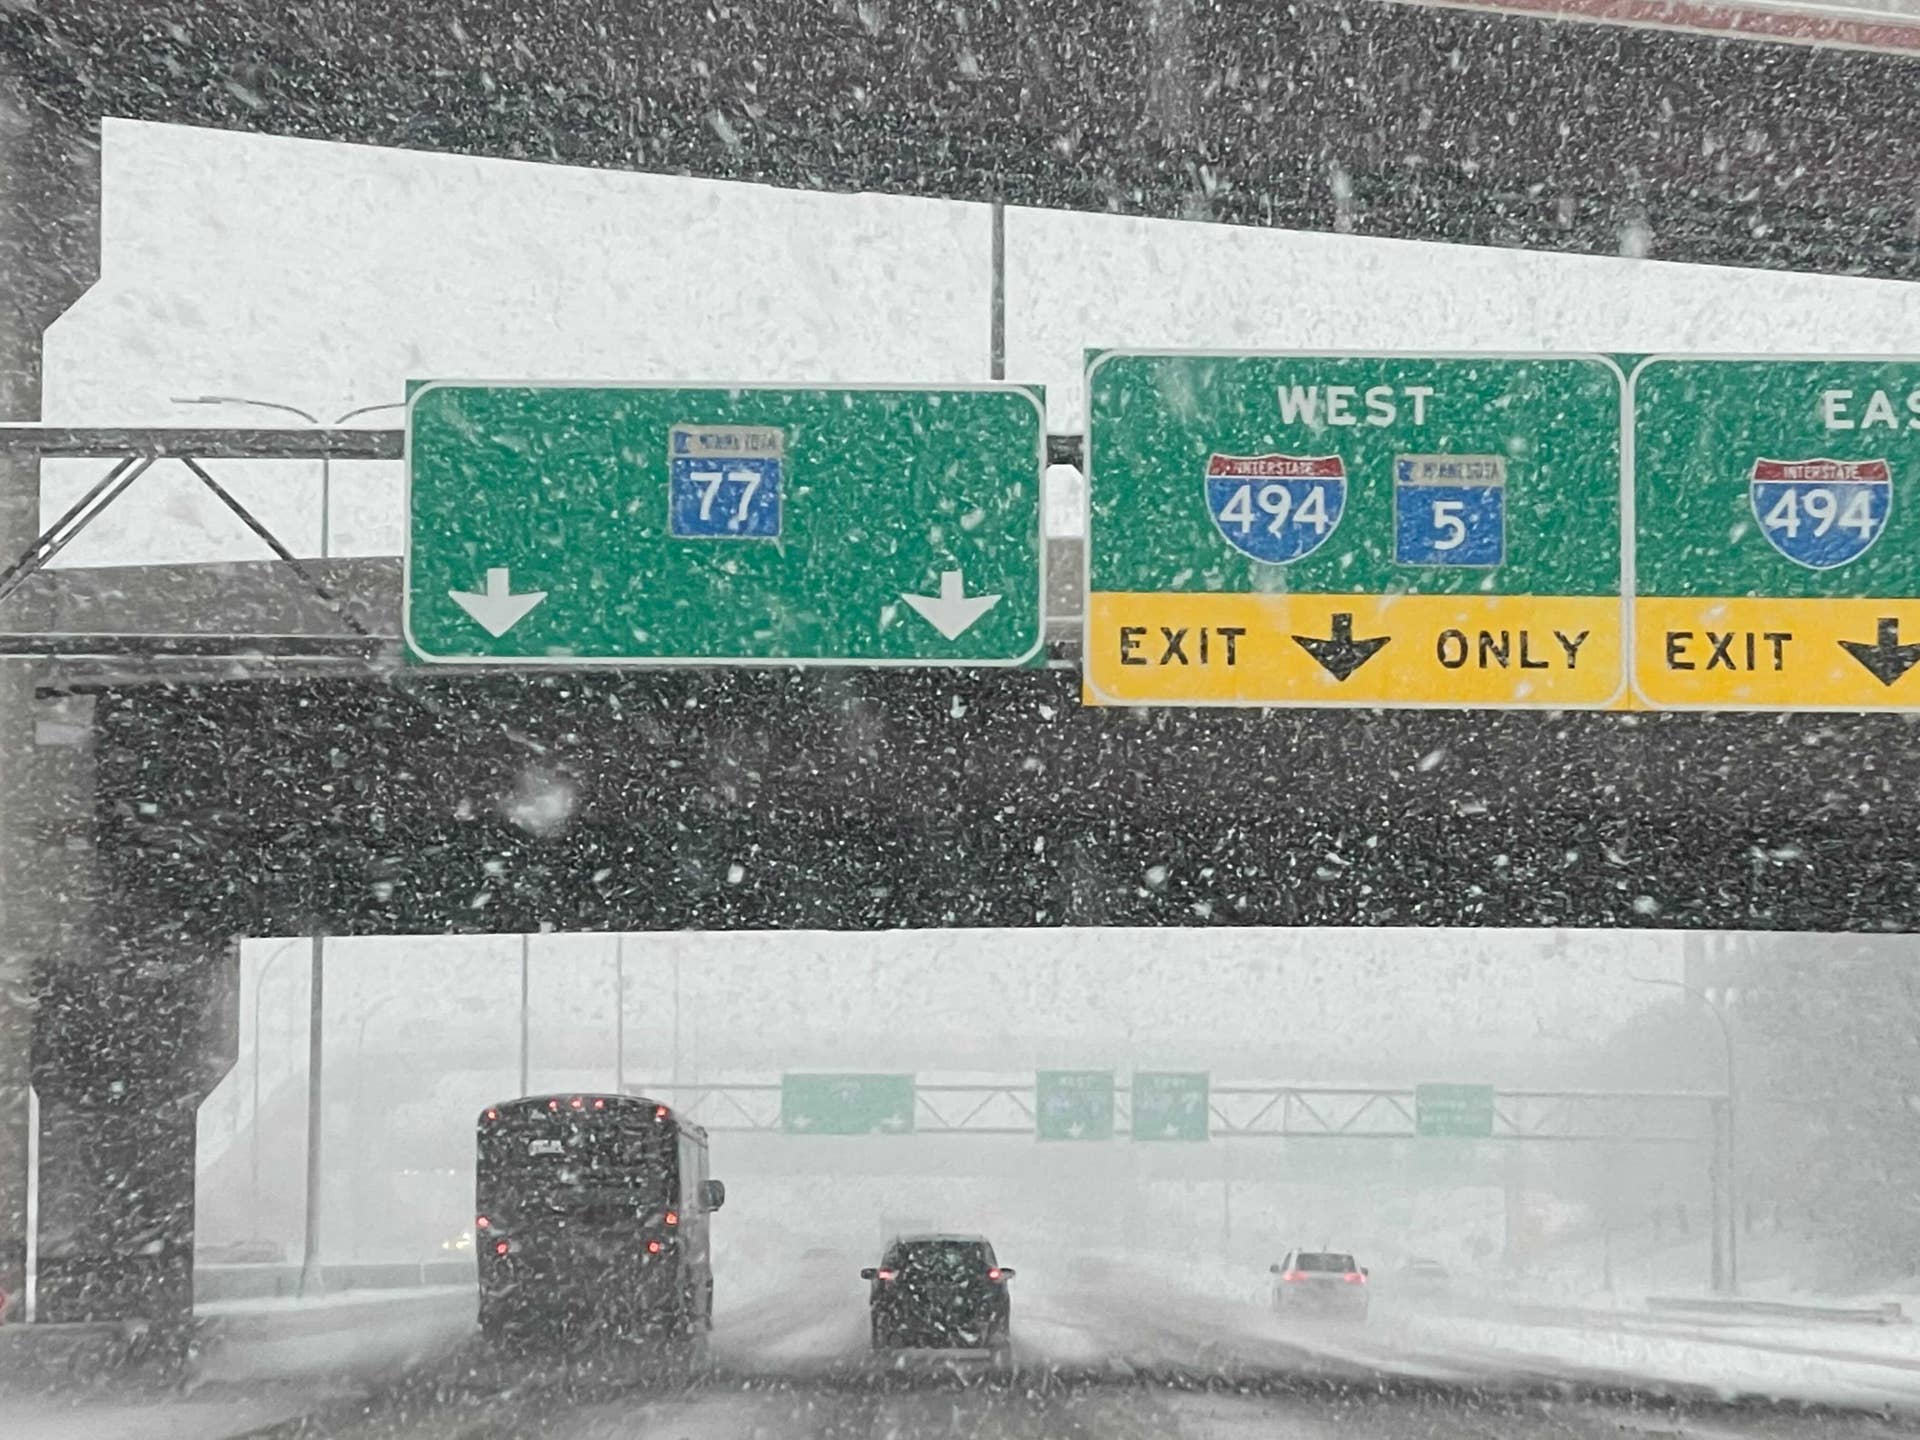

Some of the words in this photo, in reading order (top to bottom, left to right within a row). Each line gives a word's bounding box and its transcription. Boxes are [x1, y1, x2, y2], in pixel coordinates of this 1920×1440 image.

[1278, 385, 1434, 427] WEST
[1783, 465, 1859, 480] INTERSTATE
[690, 471, 761, 521] 77
[1219, 485, 1330, 537] 494
[1763, 487, 1880, 539] 494
[1432, 501, 1467, 550] 5
[1119, 626, 1247, 667] EXIT
[1436, 628, 1591, 670] ONLY
[1665, 631, 1793, 671] EXIT
